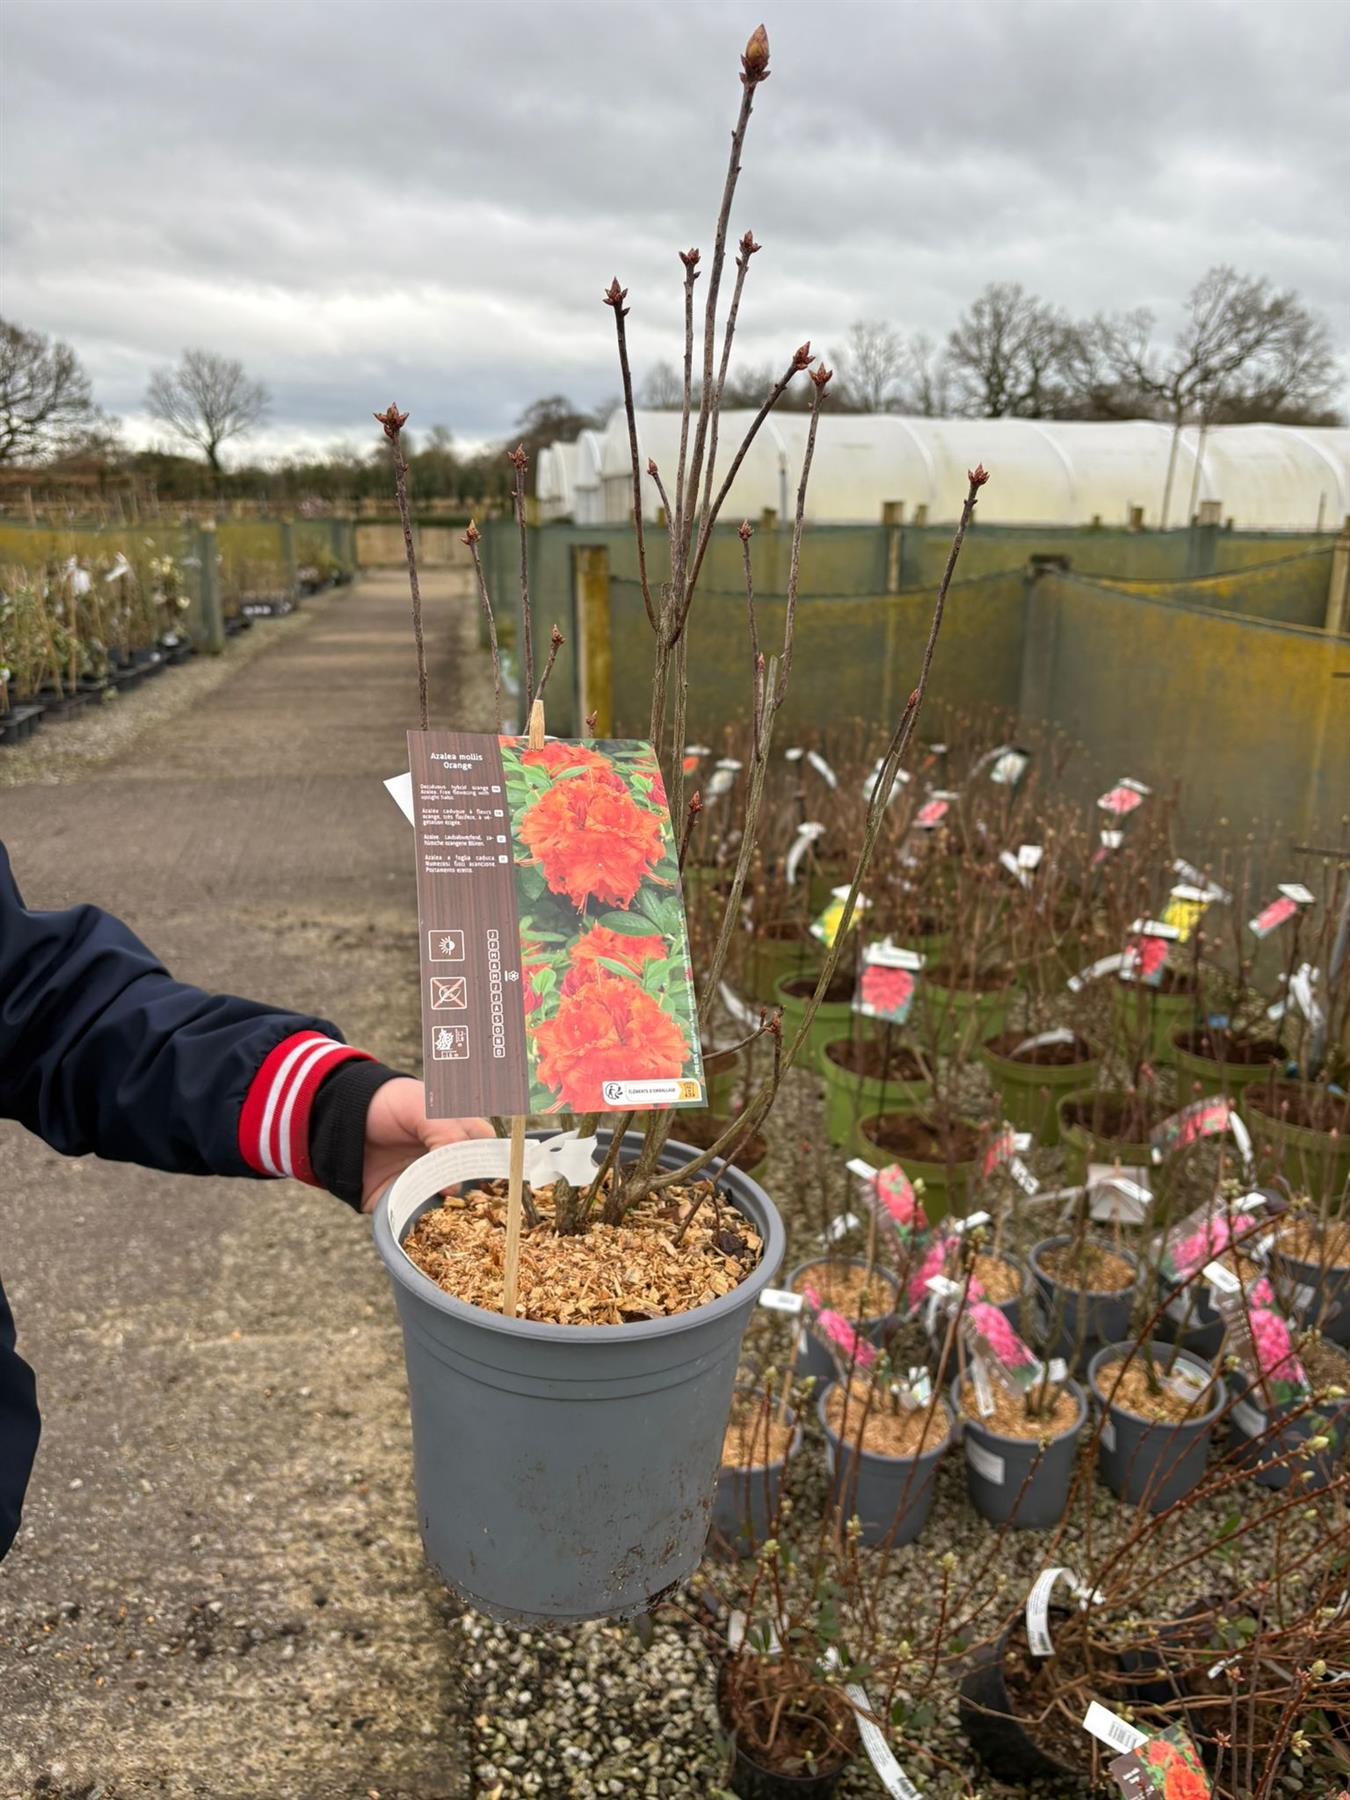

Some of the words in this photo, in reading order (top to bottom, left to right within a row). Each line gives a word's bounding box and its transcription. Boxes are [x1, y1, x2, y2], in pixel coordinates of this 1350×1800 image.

[431, 752, 457, 760] Azalea
[459, 753, 483, 761] mollis
[443, 762, 472, 770] Orange
